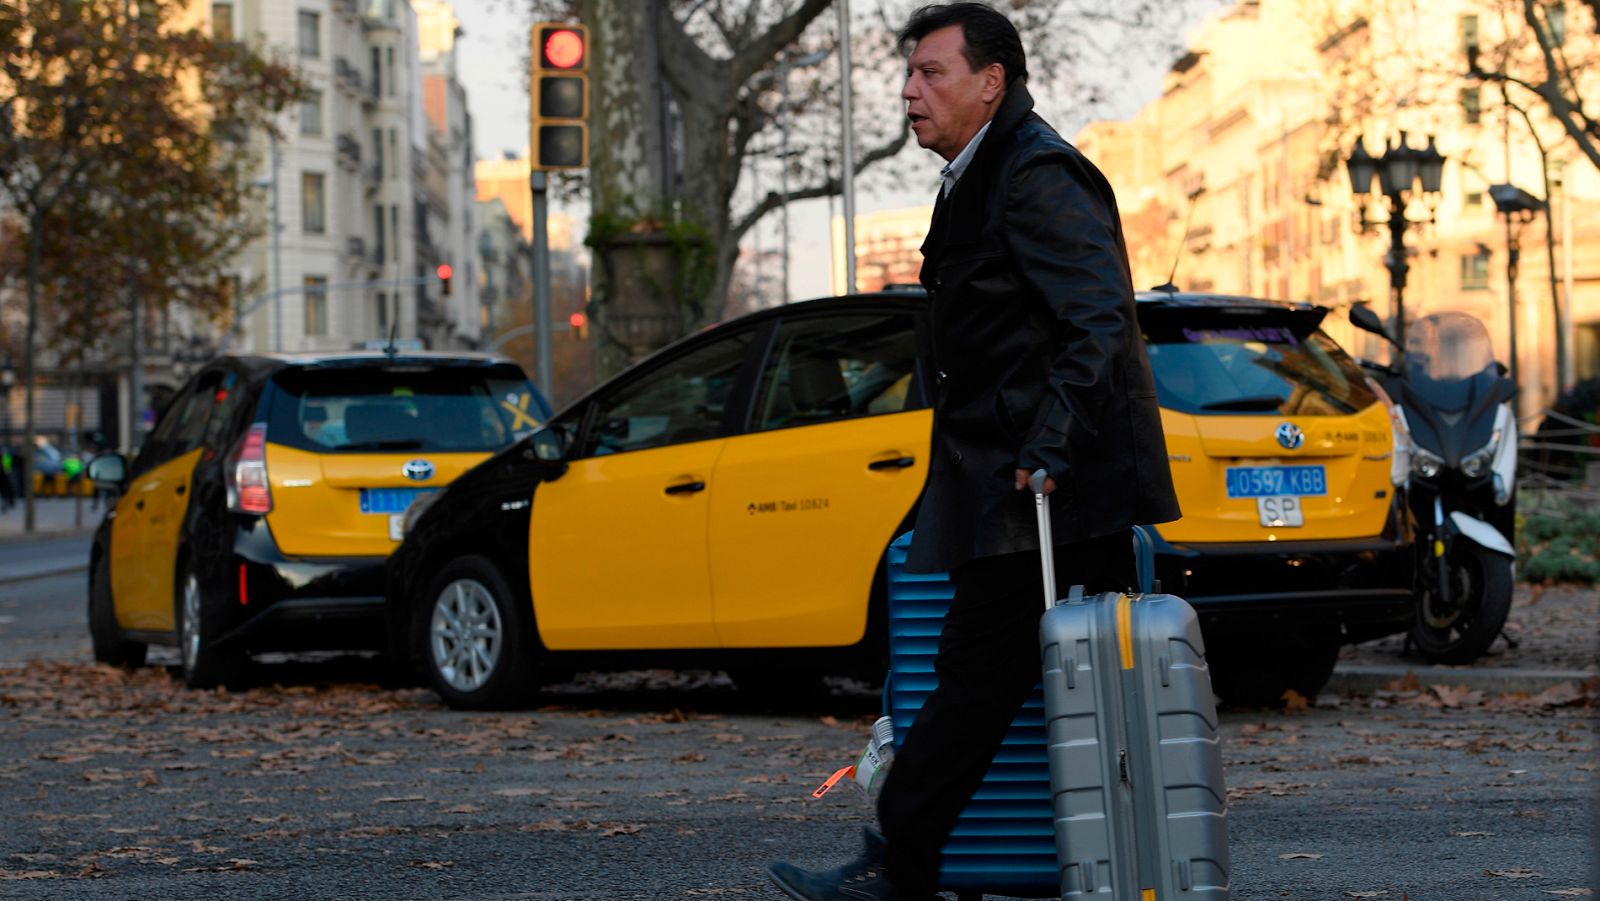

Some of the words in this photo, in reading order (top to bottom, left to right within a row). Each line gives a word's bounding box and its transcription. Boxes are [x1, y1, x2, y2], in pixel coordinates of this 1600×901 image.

[1239, 470, 1284, 493] 0597
[1290, 469, 1324, 492] KBB
[1263, 498, 1296, 522] SP
